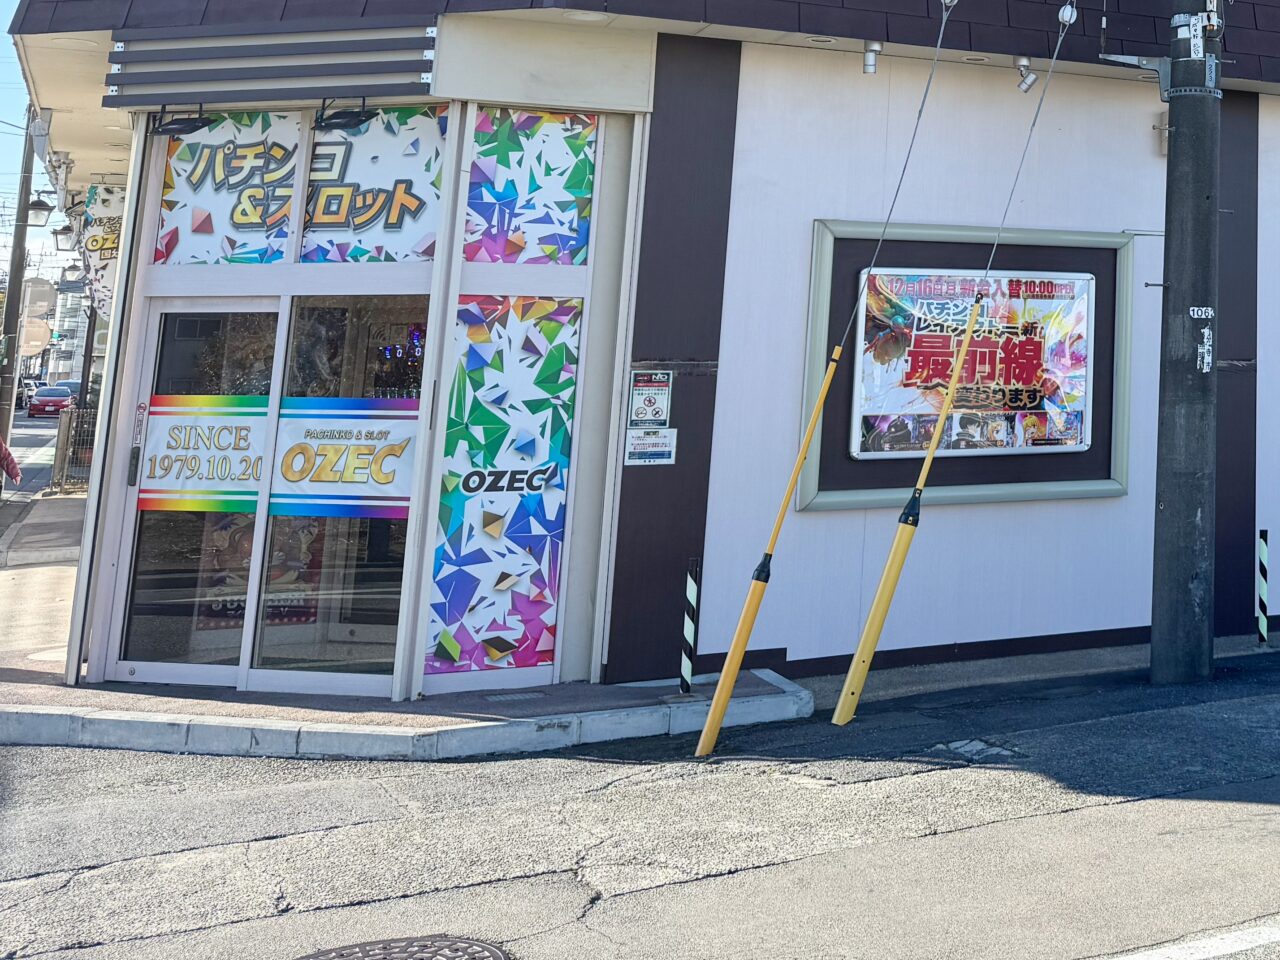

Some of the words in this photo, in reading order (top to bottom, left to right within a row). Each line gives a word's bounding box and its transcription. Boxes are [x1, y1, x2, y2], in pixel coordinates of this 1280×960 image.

[186, 139, 353, 192] パチンコ
[229, 179, 427, 235] &スロット
[905, 336, 1044, 386] 最前線
[166, 425, 251, 450] SINCE
[304, 429, 353, 439] PACHINKO
[355, 429, 362, 439] &
[364, 430, 390, 440] SLOT
[280, 437, 411, 484] OZEC
[462, 463, 554, 494] OZEC
